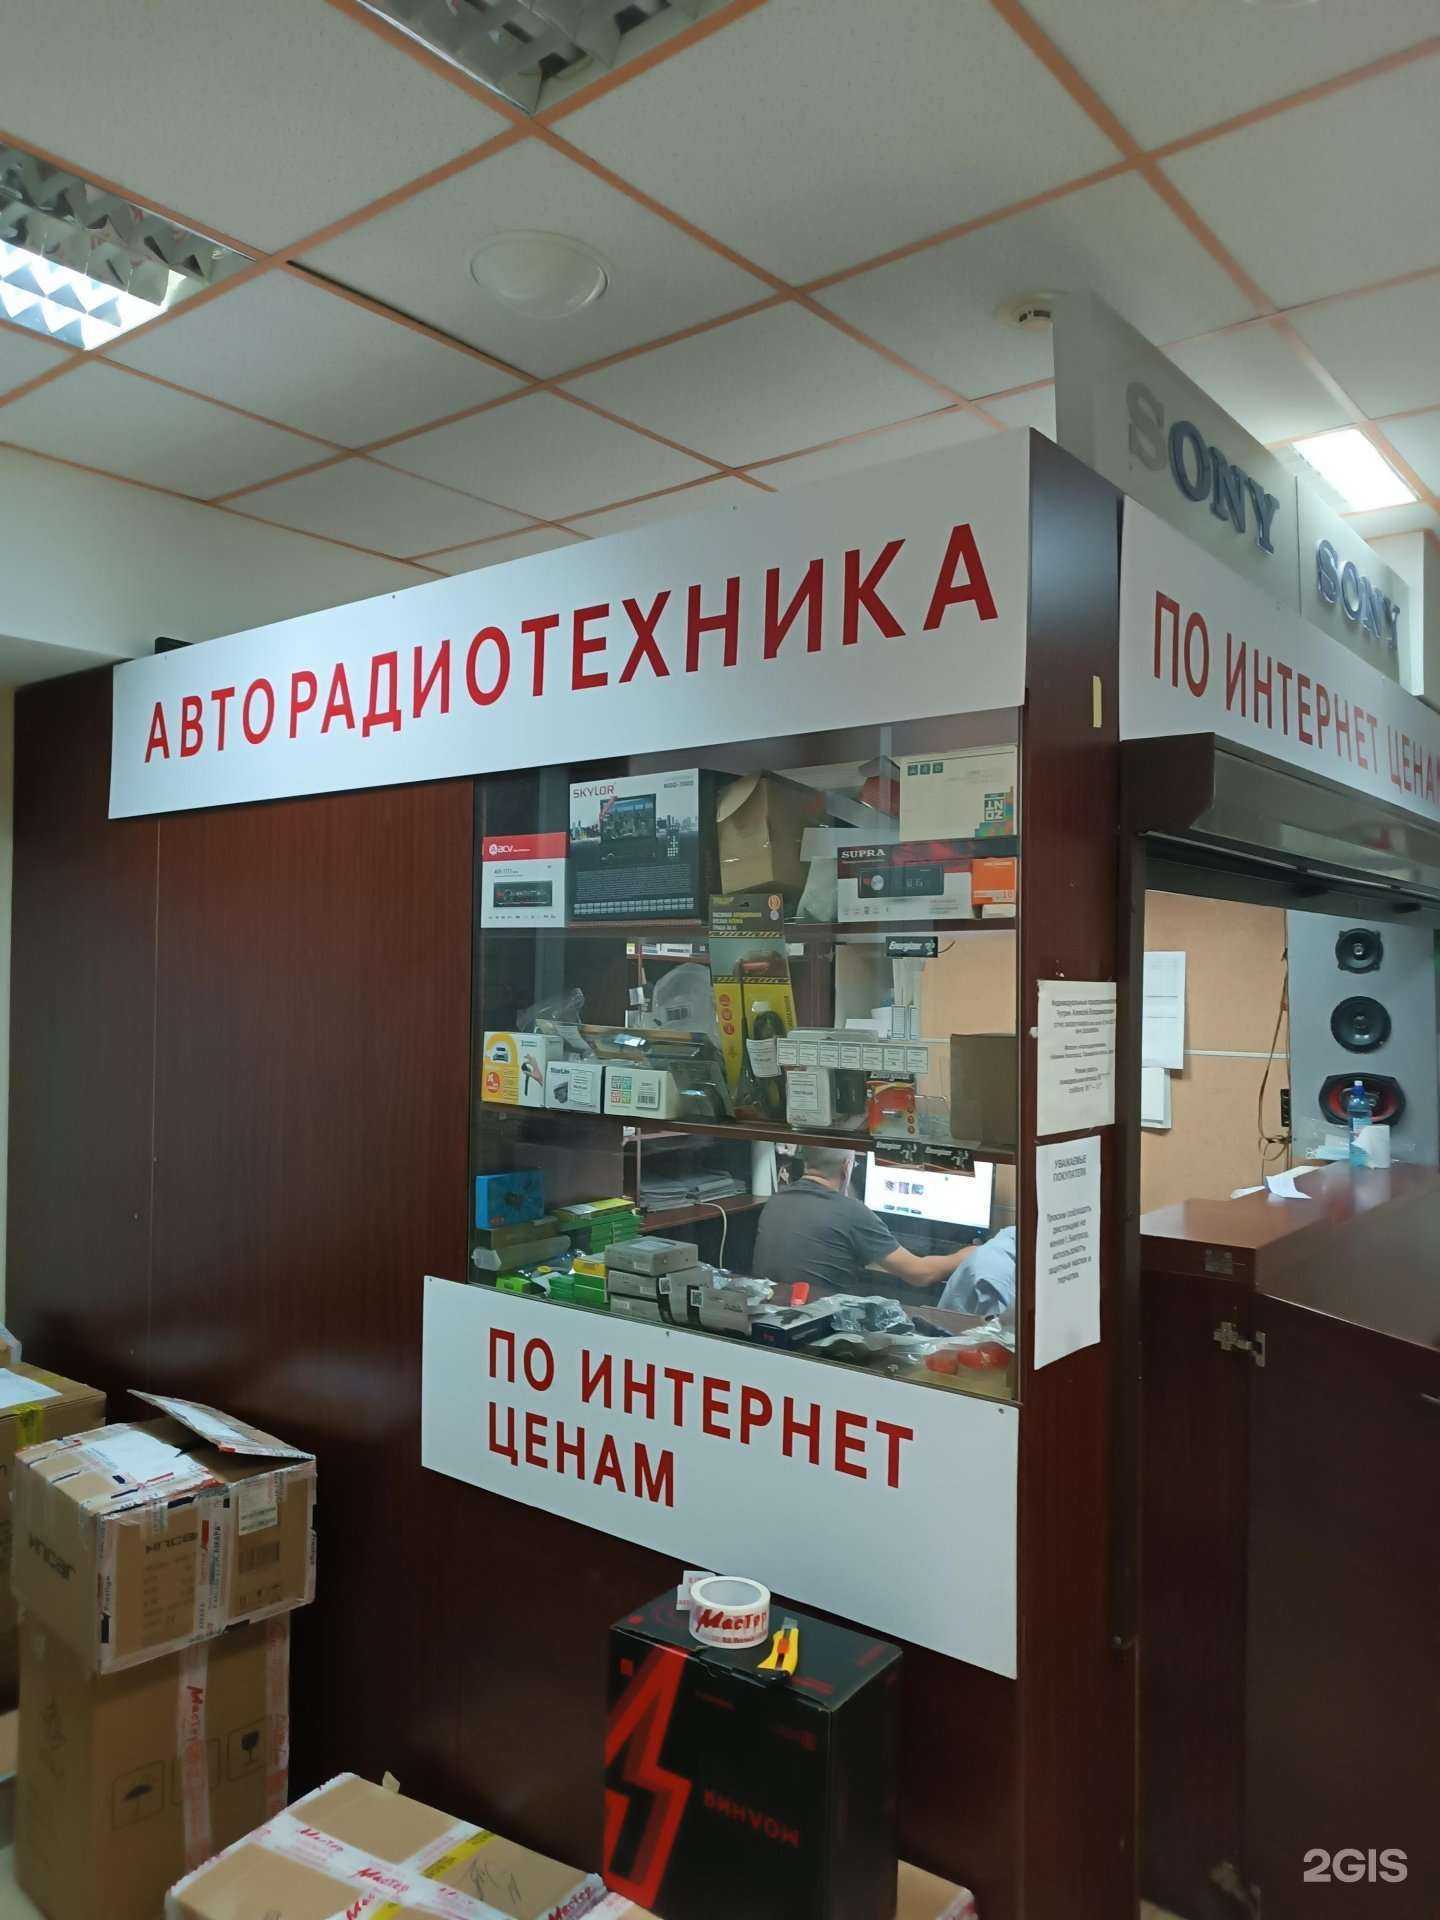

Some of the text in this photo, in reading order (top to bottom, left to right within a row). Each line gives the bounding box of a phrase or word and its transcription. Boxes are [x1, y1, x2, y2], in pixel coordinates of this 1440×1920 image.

[146, 524, 999, 761] АВТОРАДИОТЕХНИКА
[1315, 538, 1402, 653] SONY
[1153, 590, 1211, 699] ПО
[1224, 631, 1380, 776] ИНТЕРНЕТ
[572, 784, 615, 799] SKYLOR
[841, 848, 887, 860] SUPRA
[488, 1327, 914, 1489] ПО ИНТЕРНЕТ
[488, 1402, 675, 1508] ЦЕНАМ
